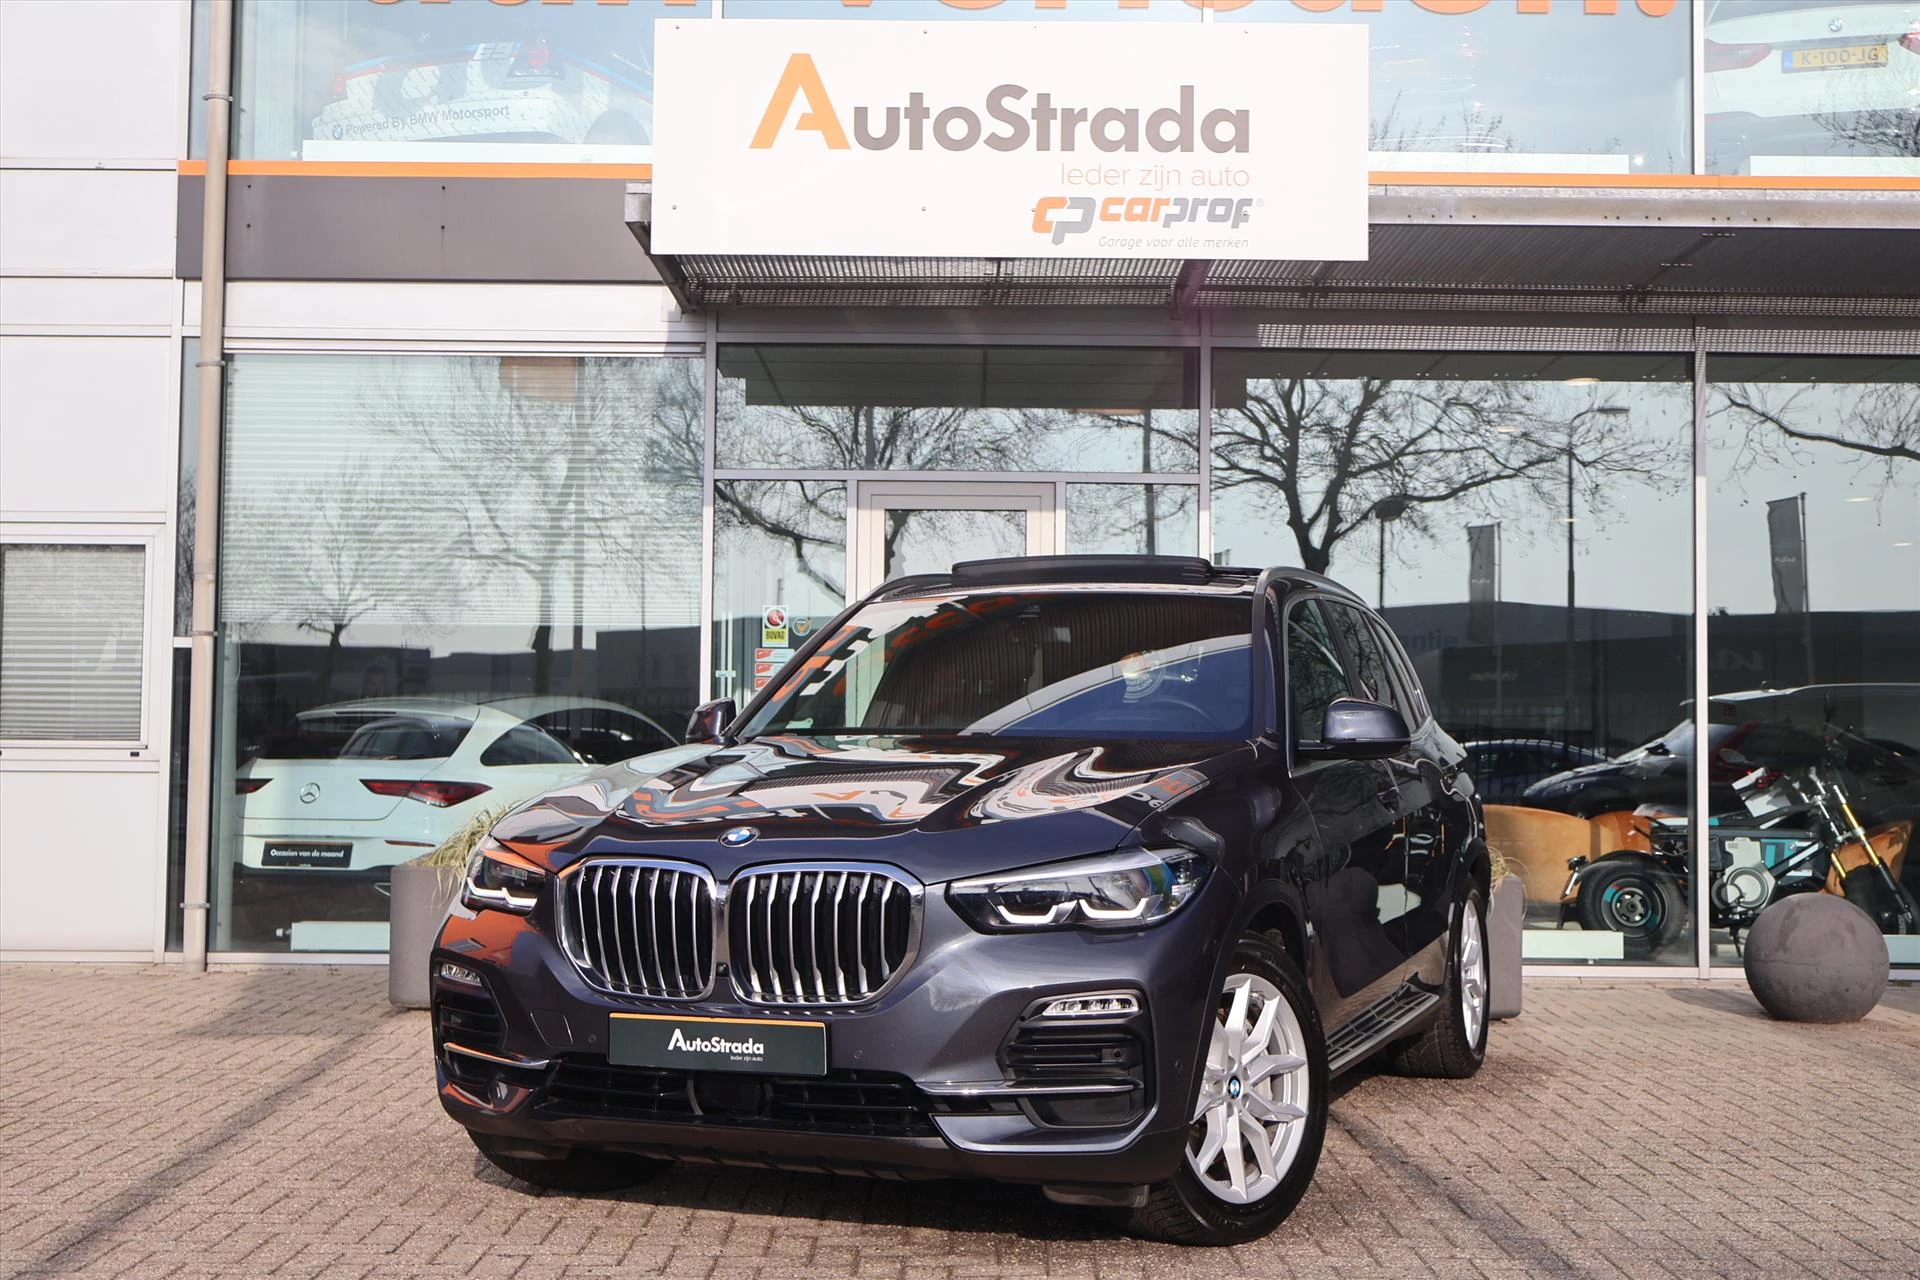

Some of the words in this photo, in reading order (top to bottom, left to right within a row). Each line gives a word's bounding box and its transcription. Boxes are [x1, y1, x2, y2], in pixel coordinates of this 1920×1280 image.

[1800, 47, 1879, 66] K-100-JG
[749, 53, 1249, 153] AutoStrada
[345, 118, 389, 136] Powered
[392, 116, 406, 130] By
[410, 110, 440, 126] BMW
[442, 104, 511, 121] Motorsport
[1061, 163, 1131, 186] Ieder
[1138, 165, 1181, 191] zijn
[1191, 167, 1250, 187] auto
[1099, 197, 1254, 229] carprof
[1098, 236, 1143, 250] Garage
[1147, 238, 1174, 248] voor
[1177, 237, 1200, 248] alle
[1203, 237, 1249, 249] merken
[765, 630, 785, 640] BOVAG
[270, 848, 298, 857] Occasion
[311, 849, 320, 857] de
[320, 850, 345, 858] maand
[667, 1028, 764, 1055] AutoStrada
